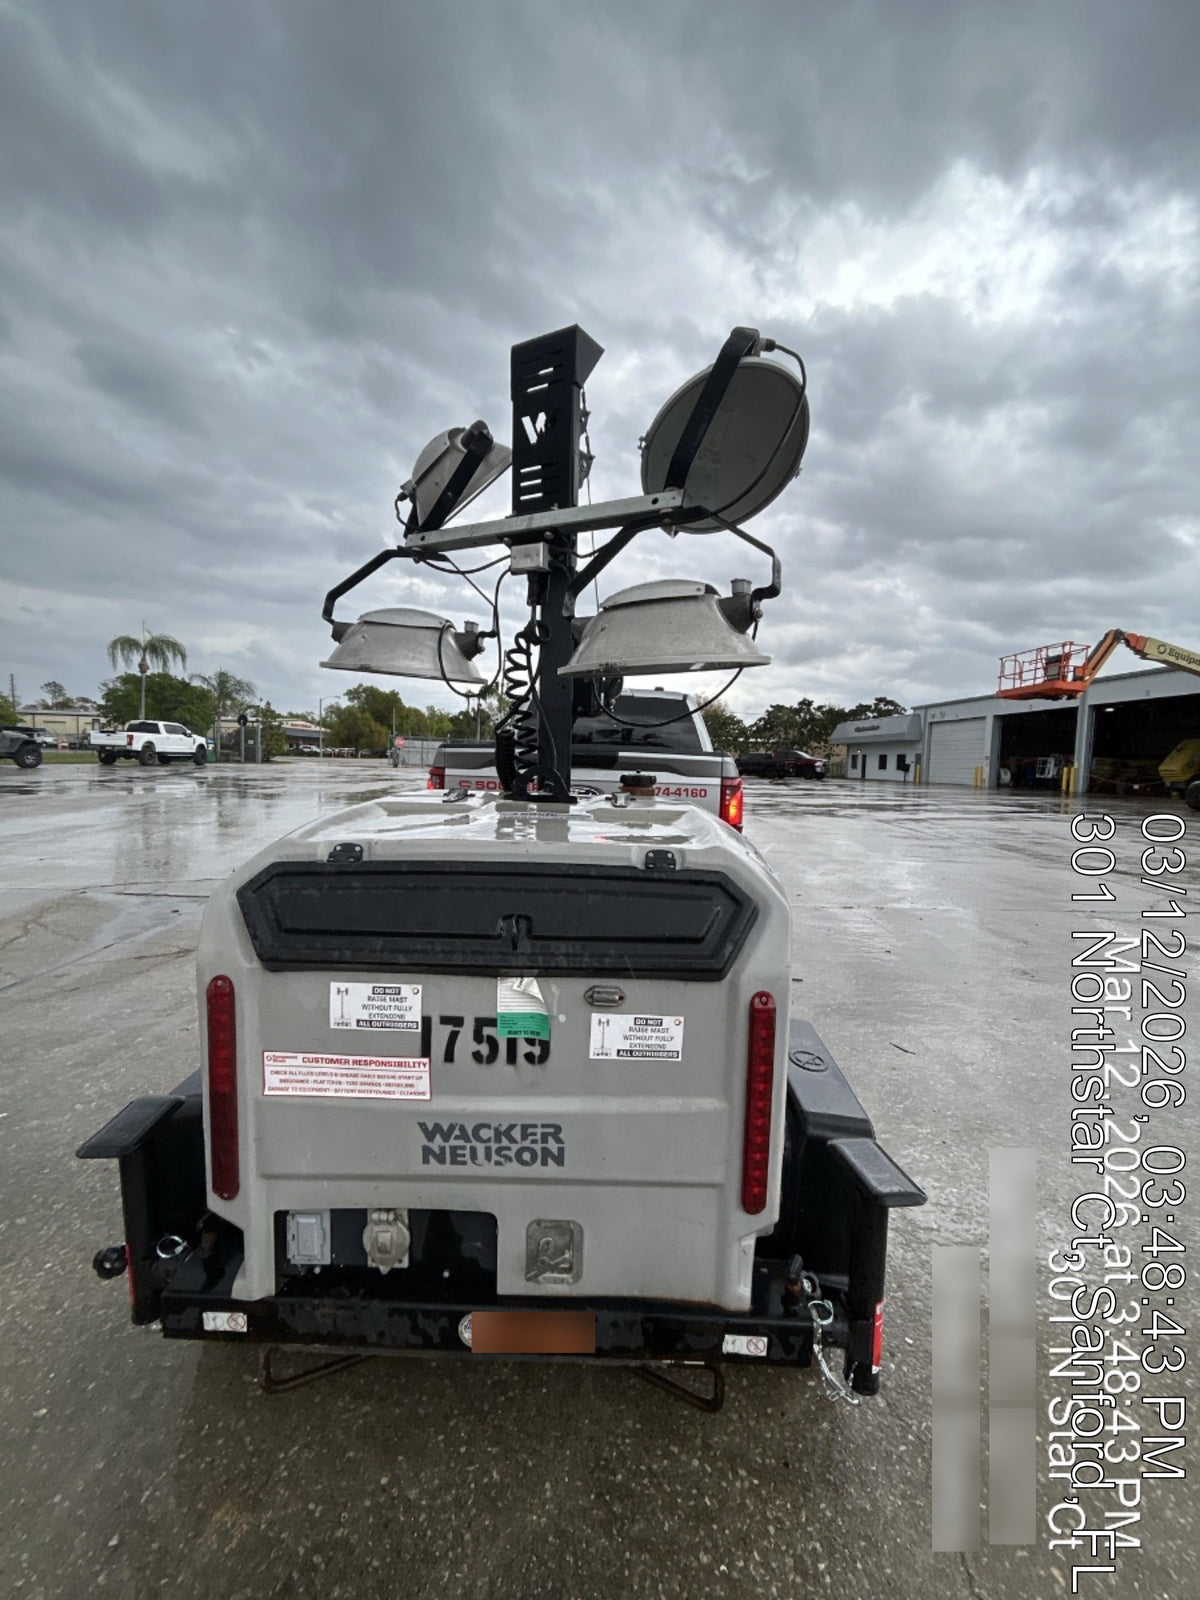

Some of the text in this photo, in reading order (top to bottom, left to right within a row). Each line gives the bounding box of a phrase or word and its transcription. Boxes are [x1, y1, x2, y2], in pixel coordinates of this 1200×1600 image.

[655, 786, 707, 798] 74-4160
[385, 987, 400, 995] NOT
[302, 1056, 427, 1069] CUSTOMER RESPONSIBILITY
[417, 1122, 565, 1145] WACKER
[422, 1144, 565, 1167] NEUSON
